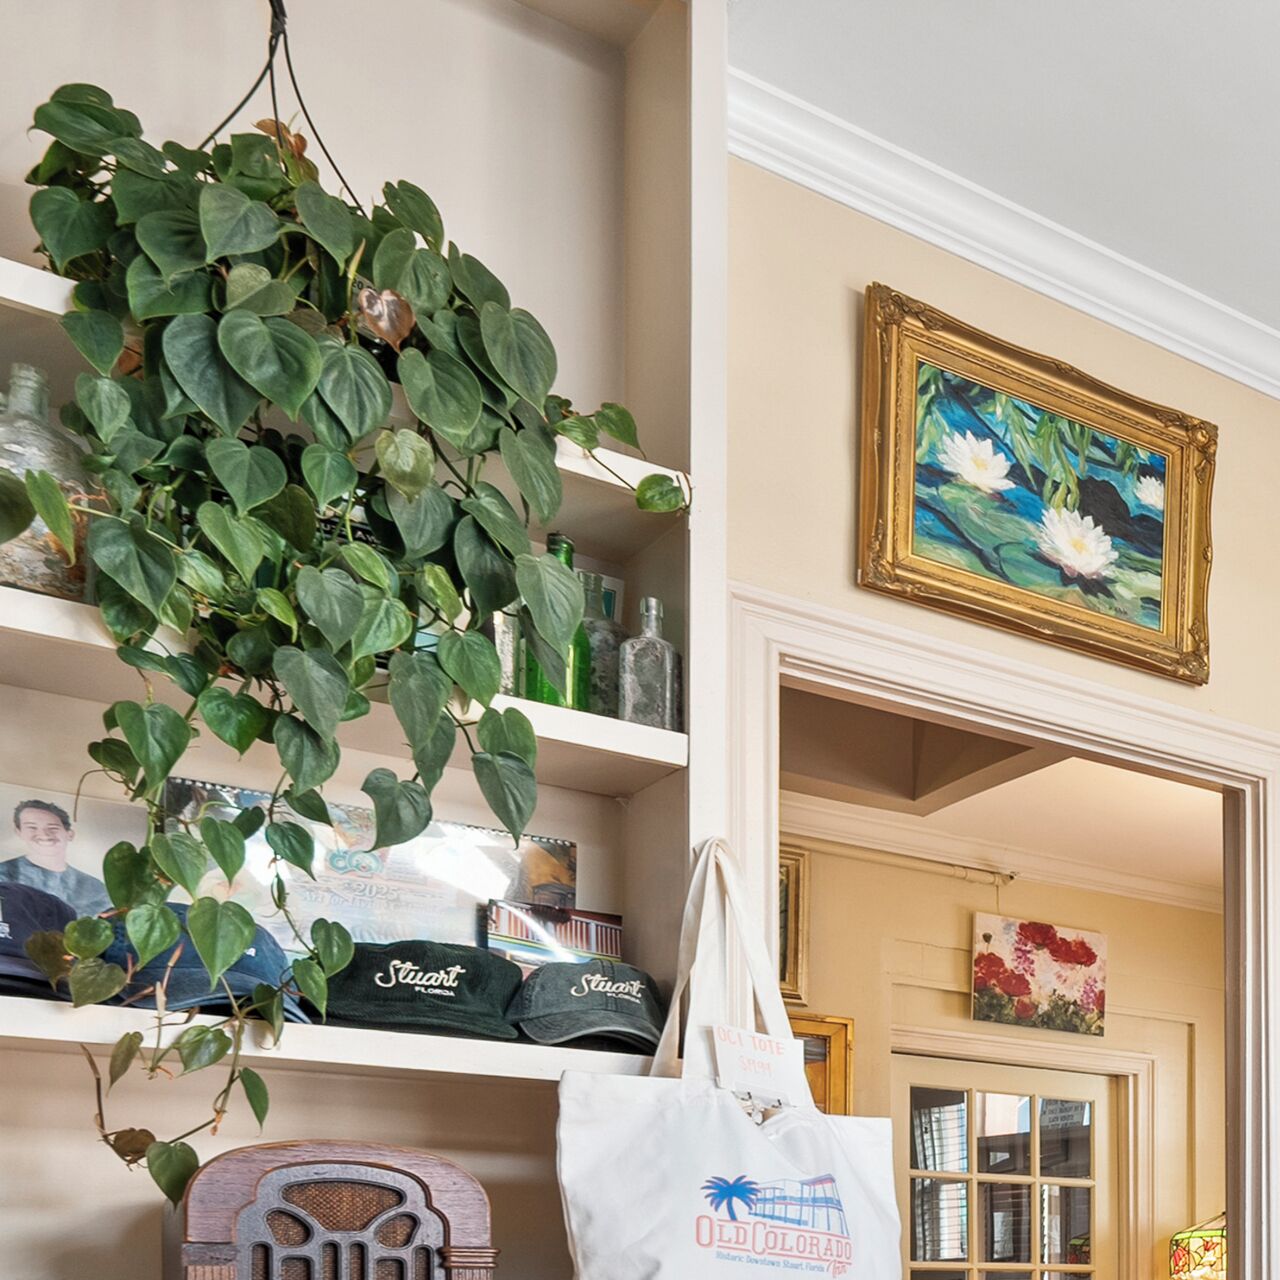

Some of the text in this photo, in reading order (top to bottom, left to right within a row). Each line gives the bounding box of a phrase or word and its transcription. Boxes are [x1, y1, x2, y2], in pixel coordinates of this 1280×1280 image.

[353, 881, 400, 900] 2025
[375, 959, 466, 988] Stuart
[414, 986, 455, 997] FLORIDA
[570, 974, 646, 999] Stuart
[696, 1214, 853, 1262] OLD COLORADO
[745, 1254, 781, 1268] Downtown
